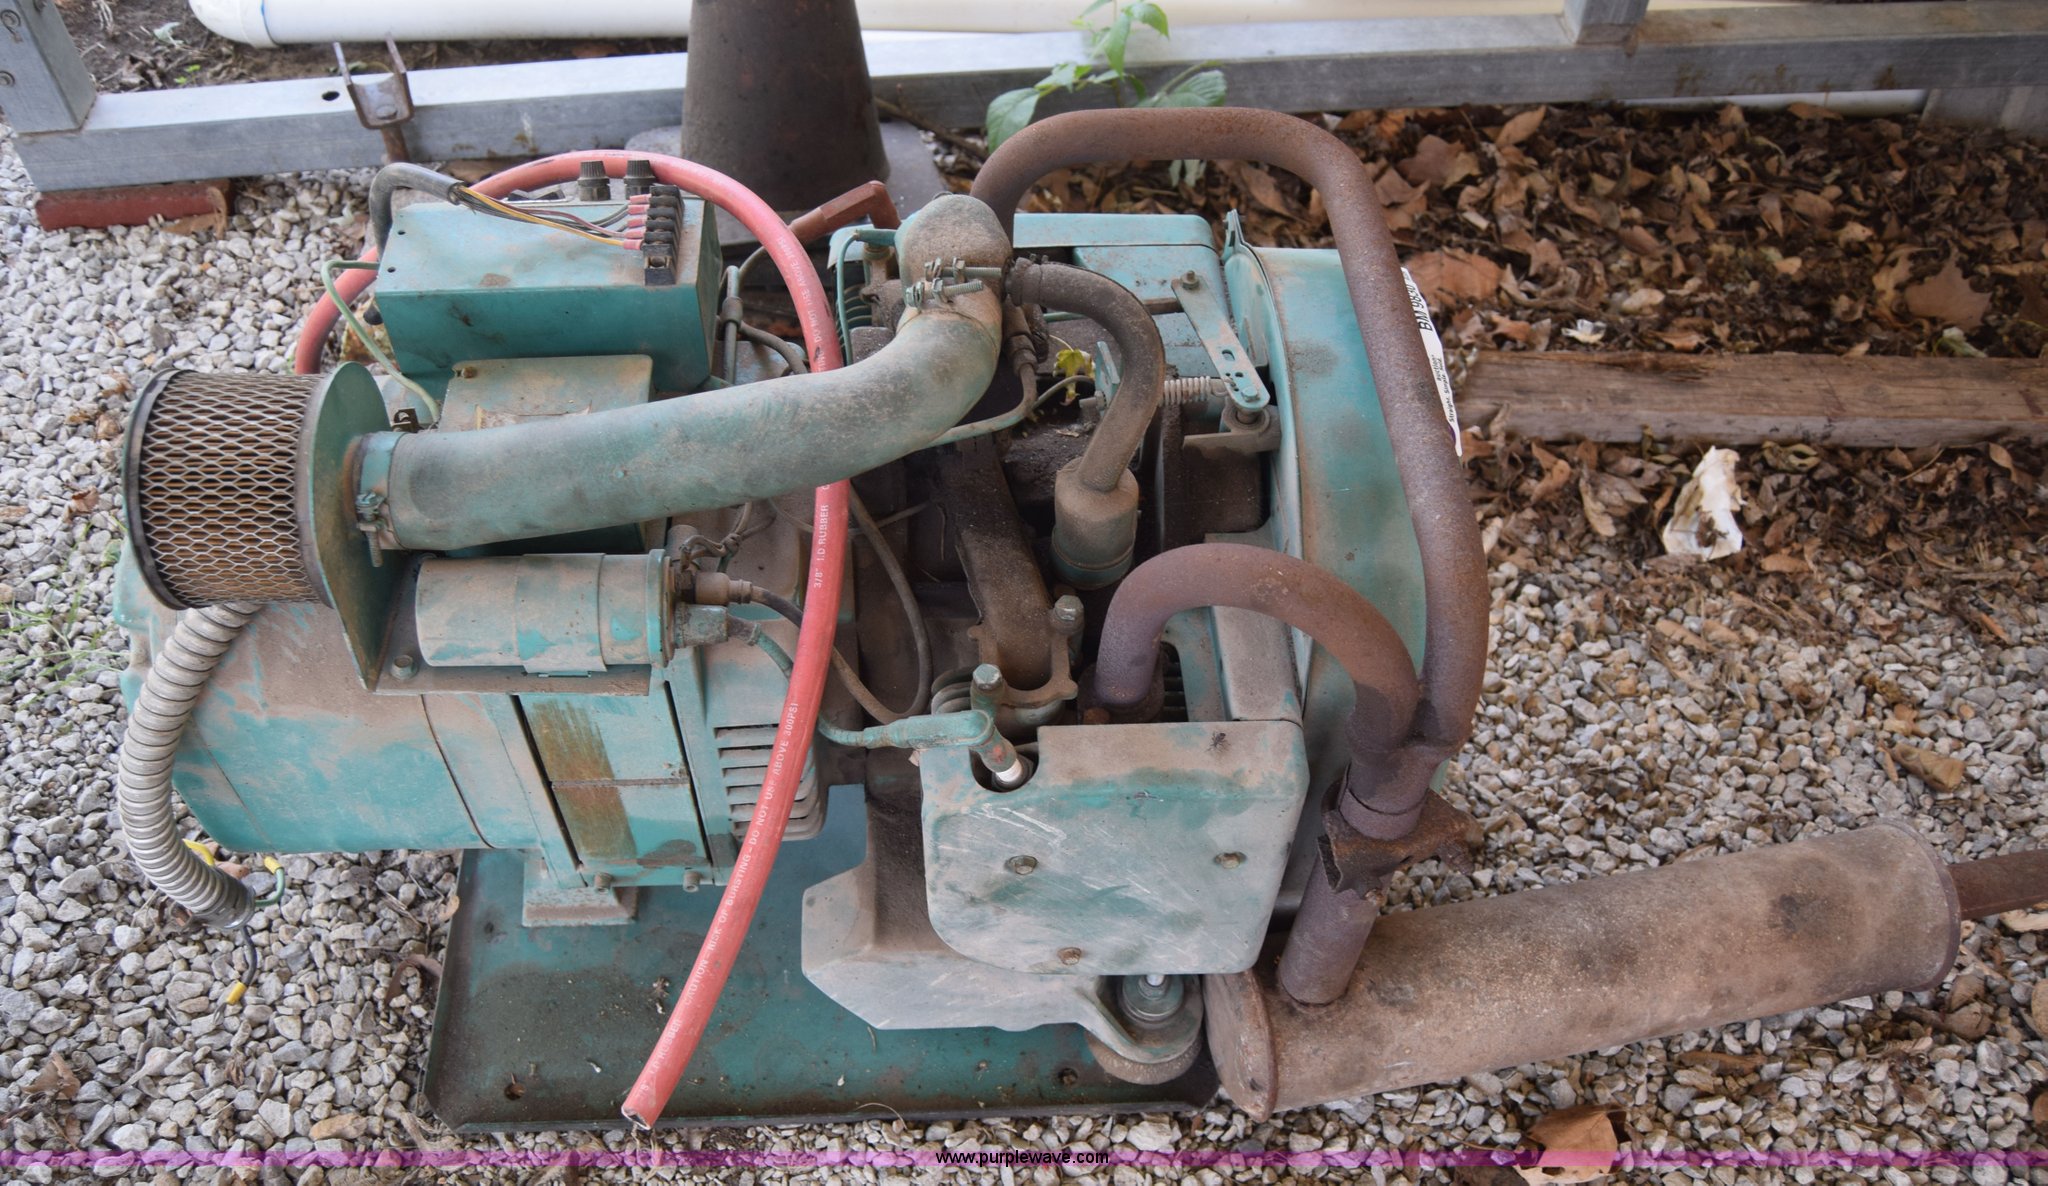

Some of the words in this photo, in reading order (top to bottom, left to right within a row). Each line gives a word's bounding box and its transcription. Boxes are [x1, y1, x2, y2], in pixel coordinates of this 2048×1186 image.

[818, 504, 829, 545] RUBBER
[684, 959, 710, 1006] CAUTION
[706, 927, 722, 951] RISK
[718, 910, 729, 924] OF
[725, 855, 751, 906] BURSTING
[750, 829, 761, 846] DO
[756, 805, 770, 826] NOT
[765, 780, 775, 800] USE
[774, 740, 789, 776] ABOVE
[786, 702, 799, 736] 300PSI
